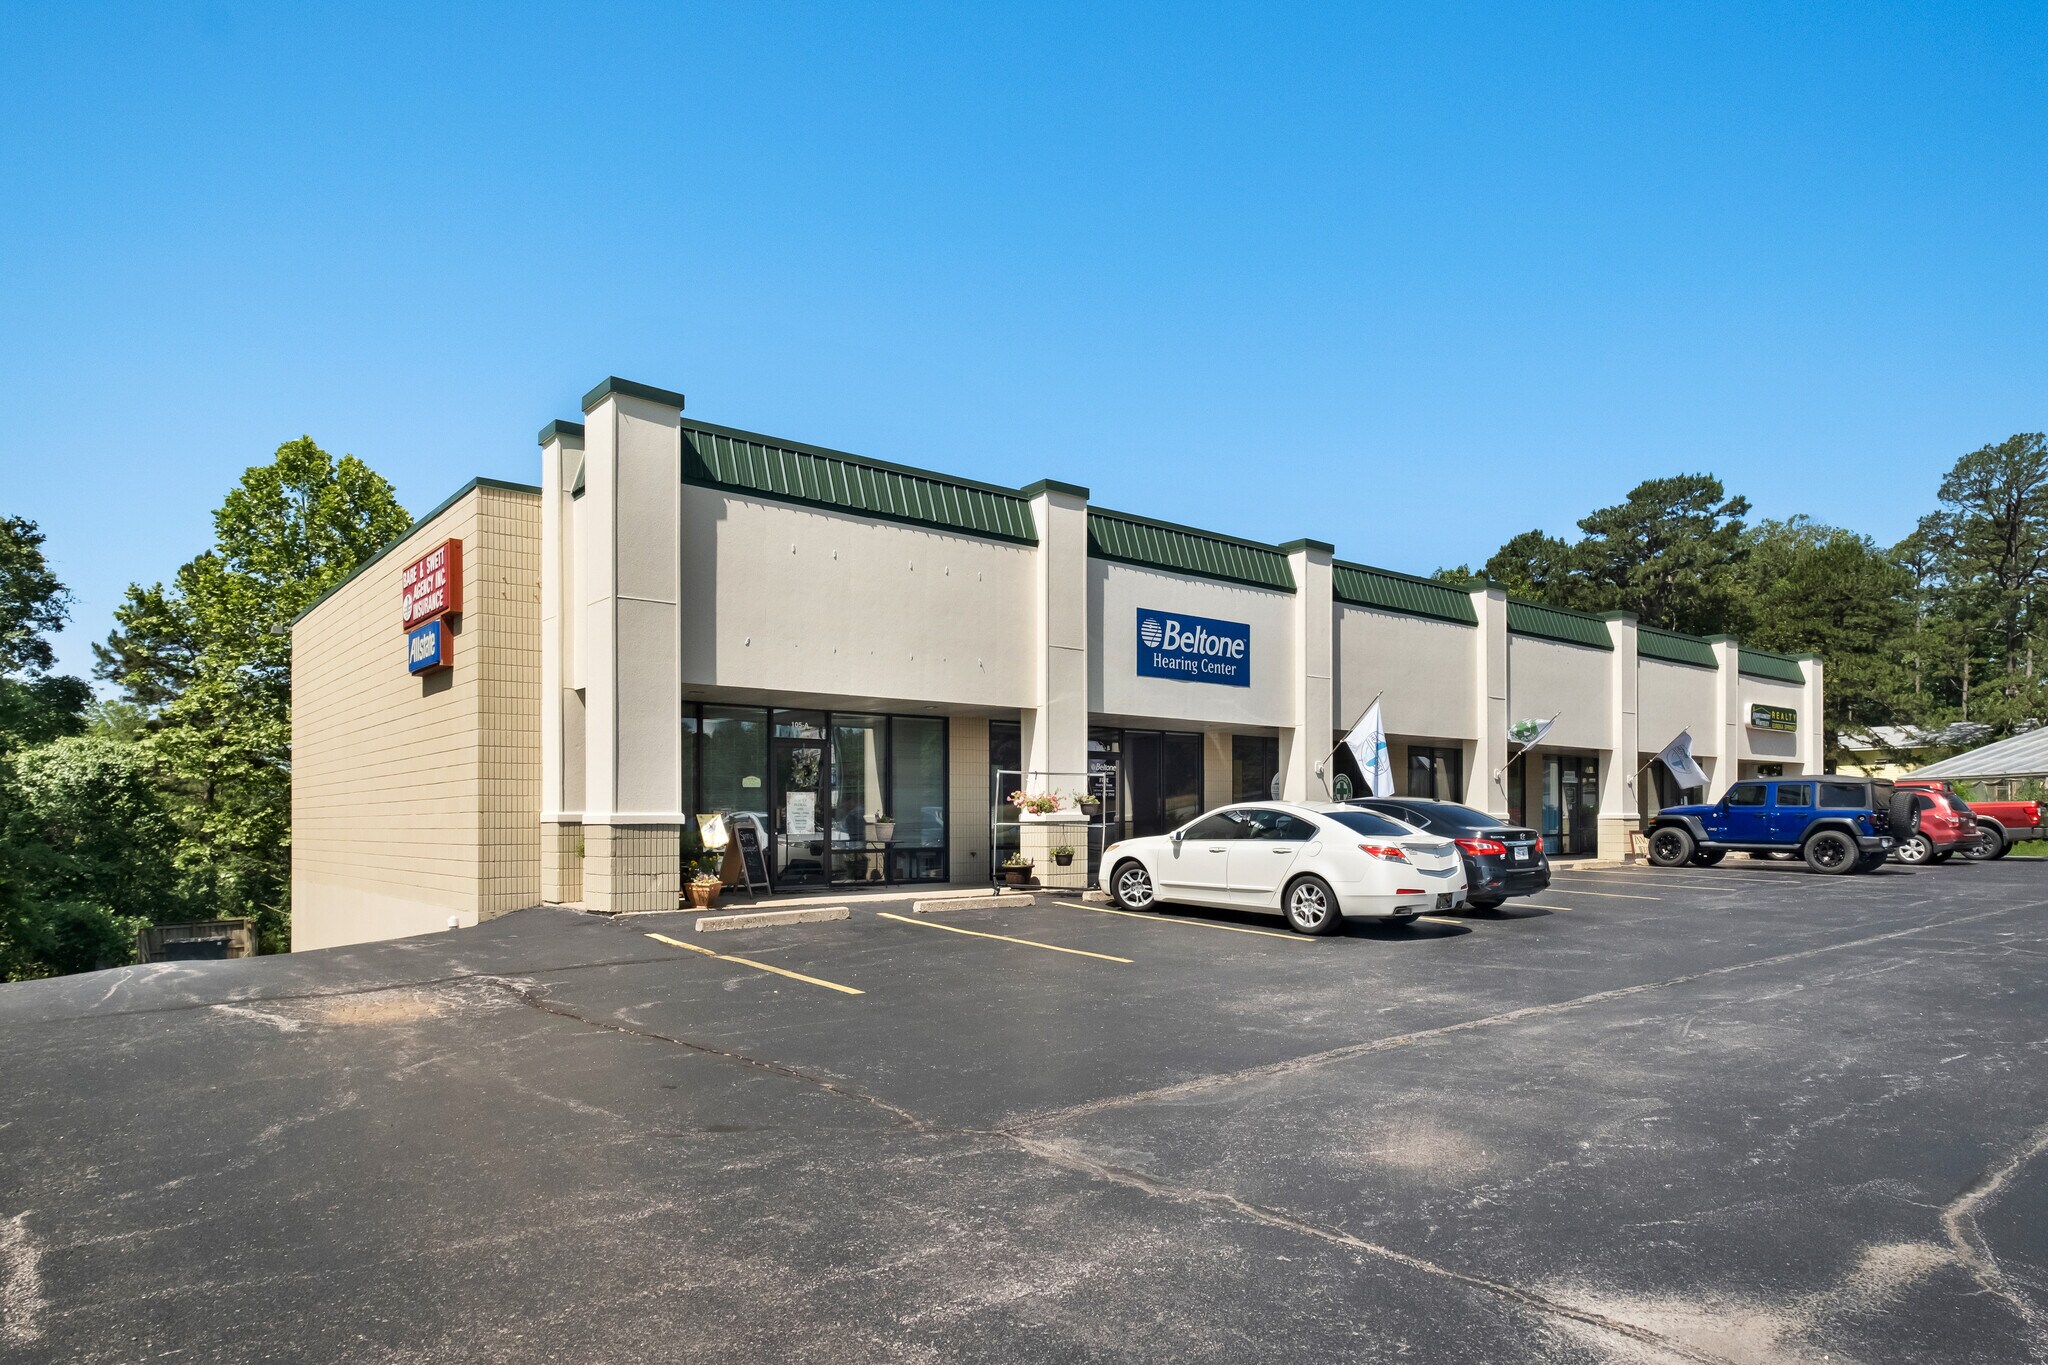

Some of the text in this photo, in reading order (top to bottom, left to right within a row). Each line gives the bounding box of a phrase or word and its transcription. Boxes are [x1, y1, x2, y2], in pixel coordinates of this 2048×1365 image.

[426, 547, 445, 574] SWETT
[413, 574, 434, 600] AGENCY
[413, 588, 443, 620] INSURANCE
[410, 631, 435, 664] Allstate
[1162, 619, 1245, 659] Beltone
[1153, 652, 1237, 676] Hearing Center
[1771, 711, 1797, 722] REALTY
